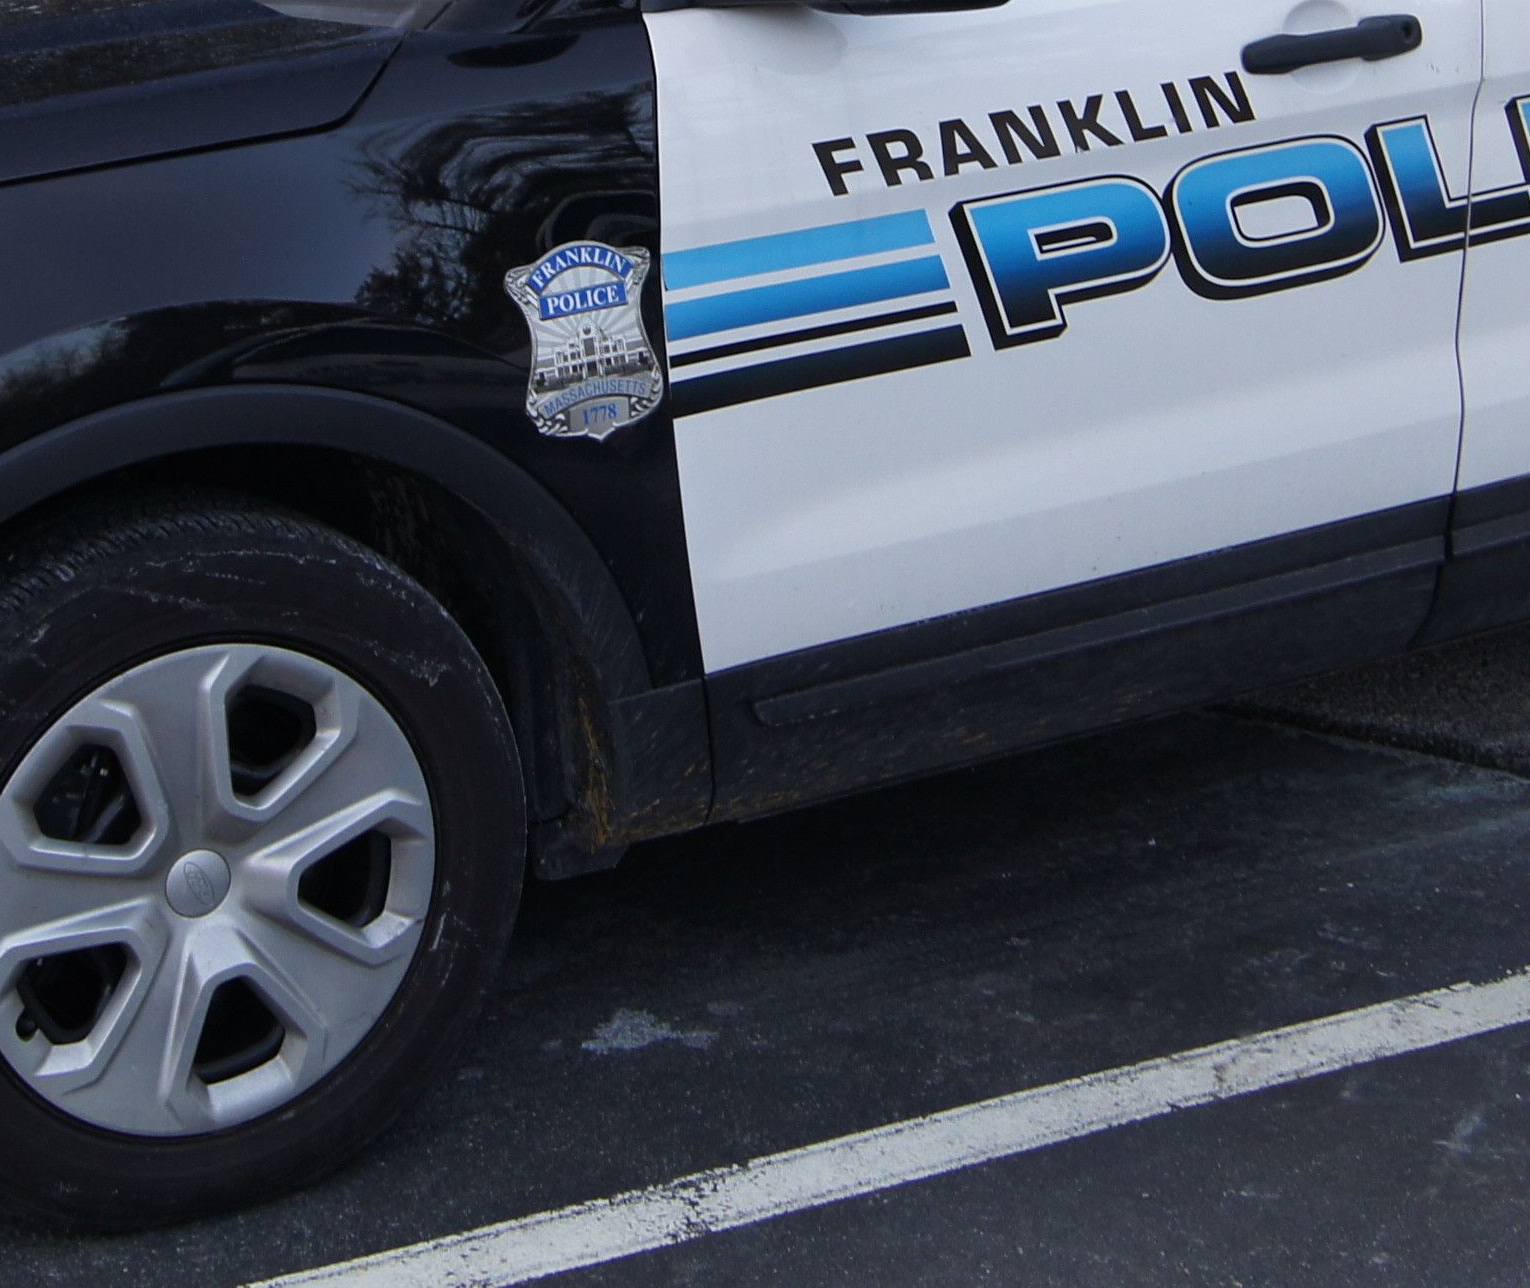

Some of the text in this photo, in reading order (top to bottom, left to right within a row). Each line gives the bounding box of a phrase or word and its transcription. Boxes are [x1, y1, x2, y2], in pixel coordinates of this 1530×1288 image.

[812, 71, 1257, 197] FRANKLIN
[532, 246, 626, 288] FRANKLIN
[546, 284, 619, 315] POLICE
[544, 379, 647, 416] MASSACHUSETTS
[582, 403, 618, 425] 1778
